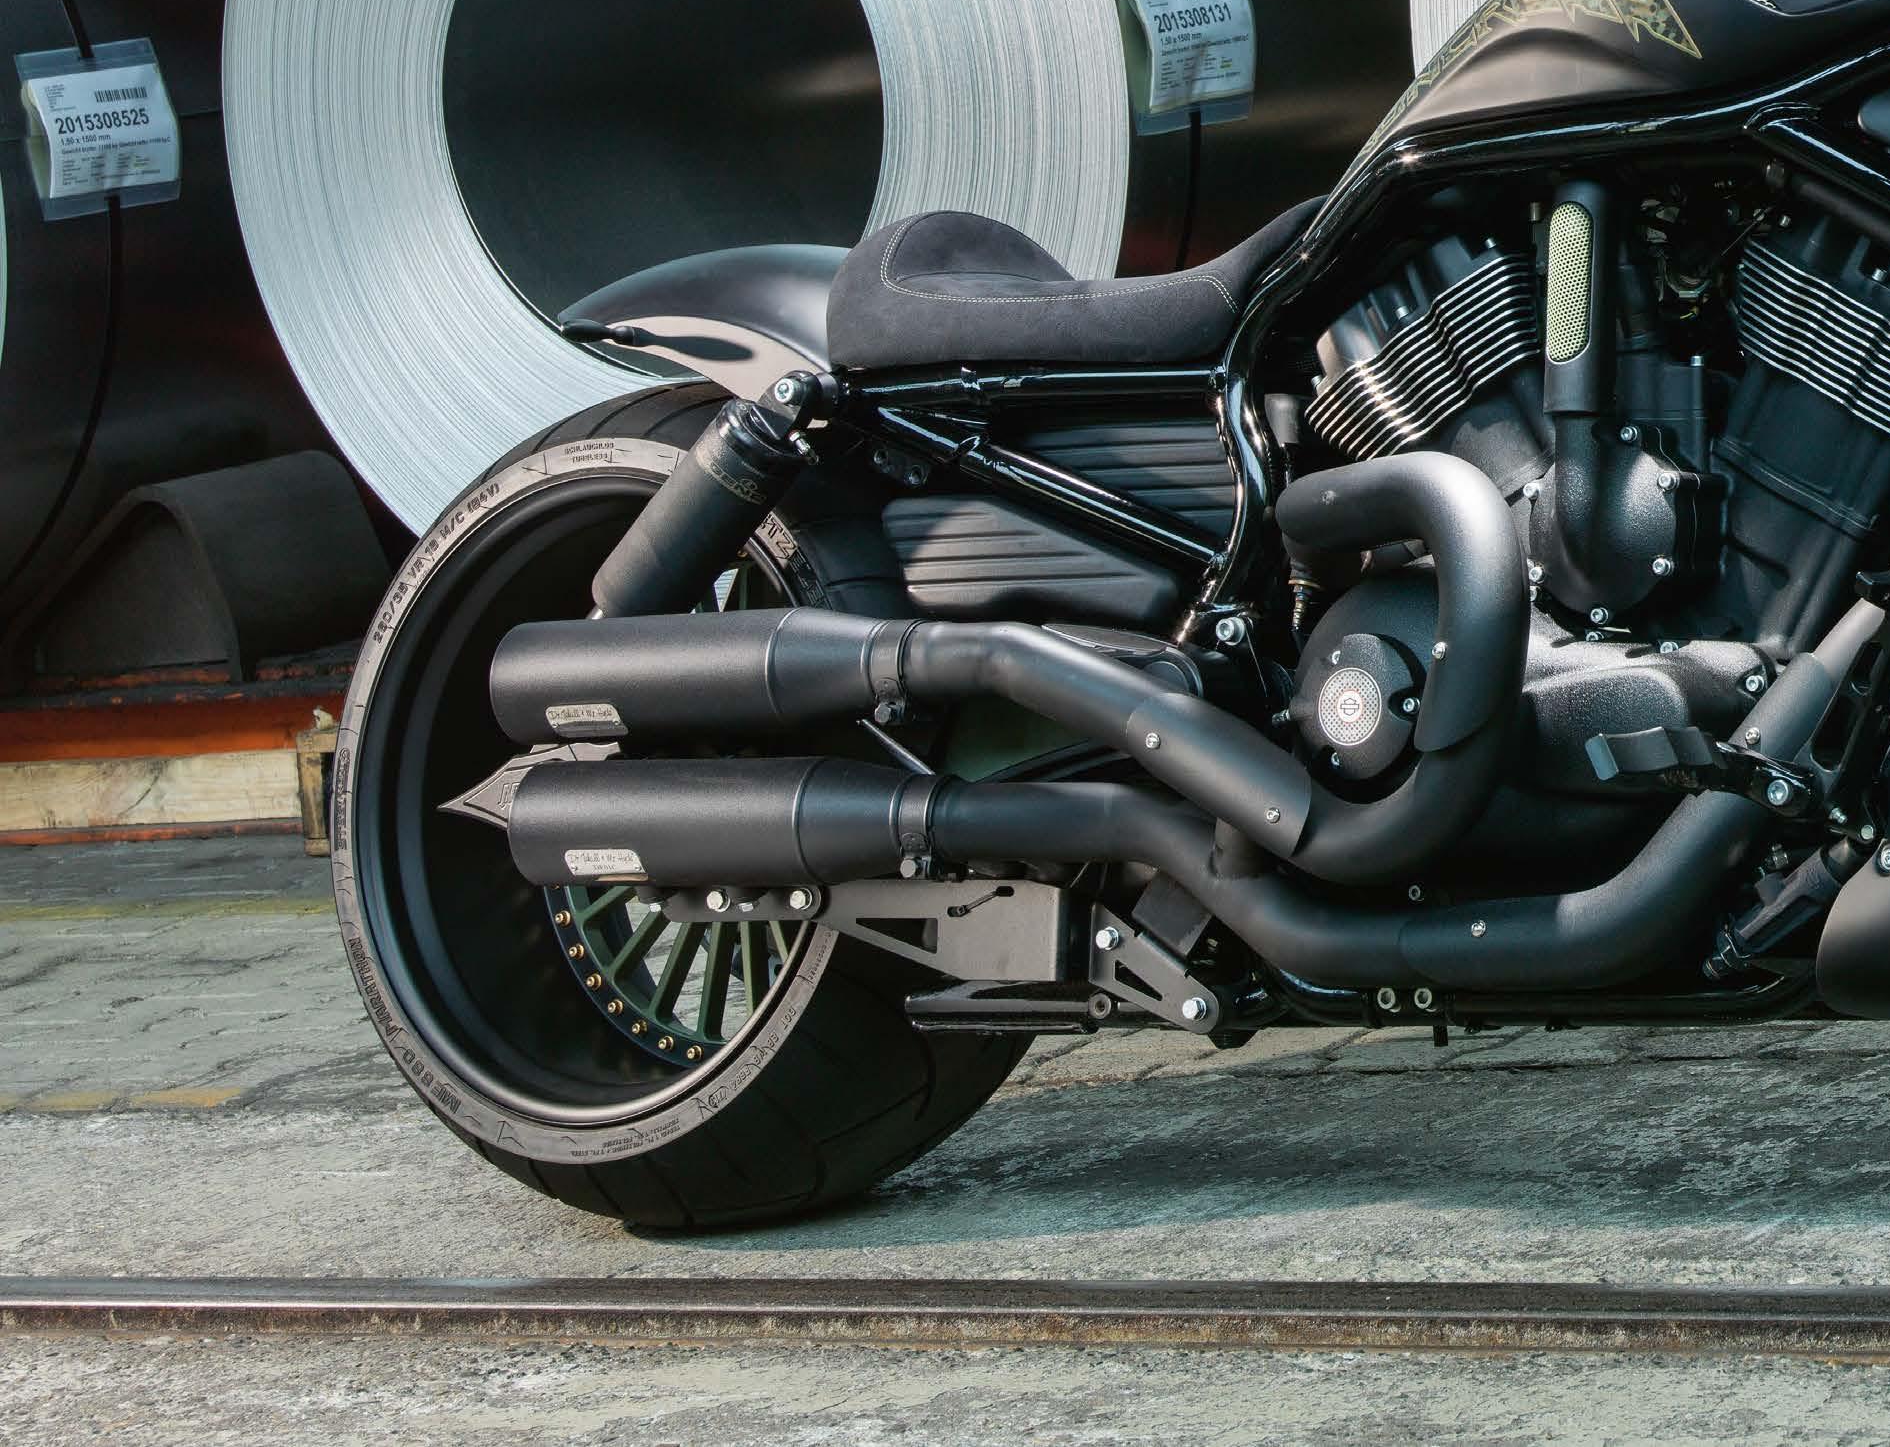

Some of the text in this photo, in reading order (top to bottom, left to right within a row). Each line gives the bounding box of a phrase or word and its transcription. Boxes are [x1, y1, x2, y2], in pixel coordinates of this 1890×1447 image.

[1153, 1, 1232, 34] 2015308131
[55, 107, 150, 135] 2015308525
[439, 510, 465, 540] M/C
[349, 936, 400, 1043] MARATHON
